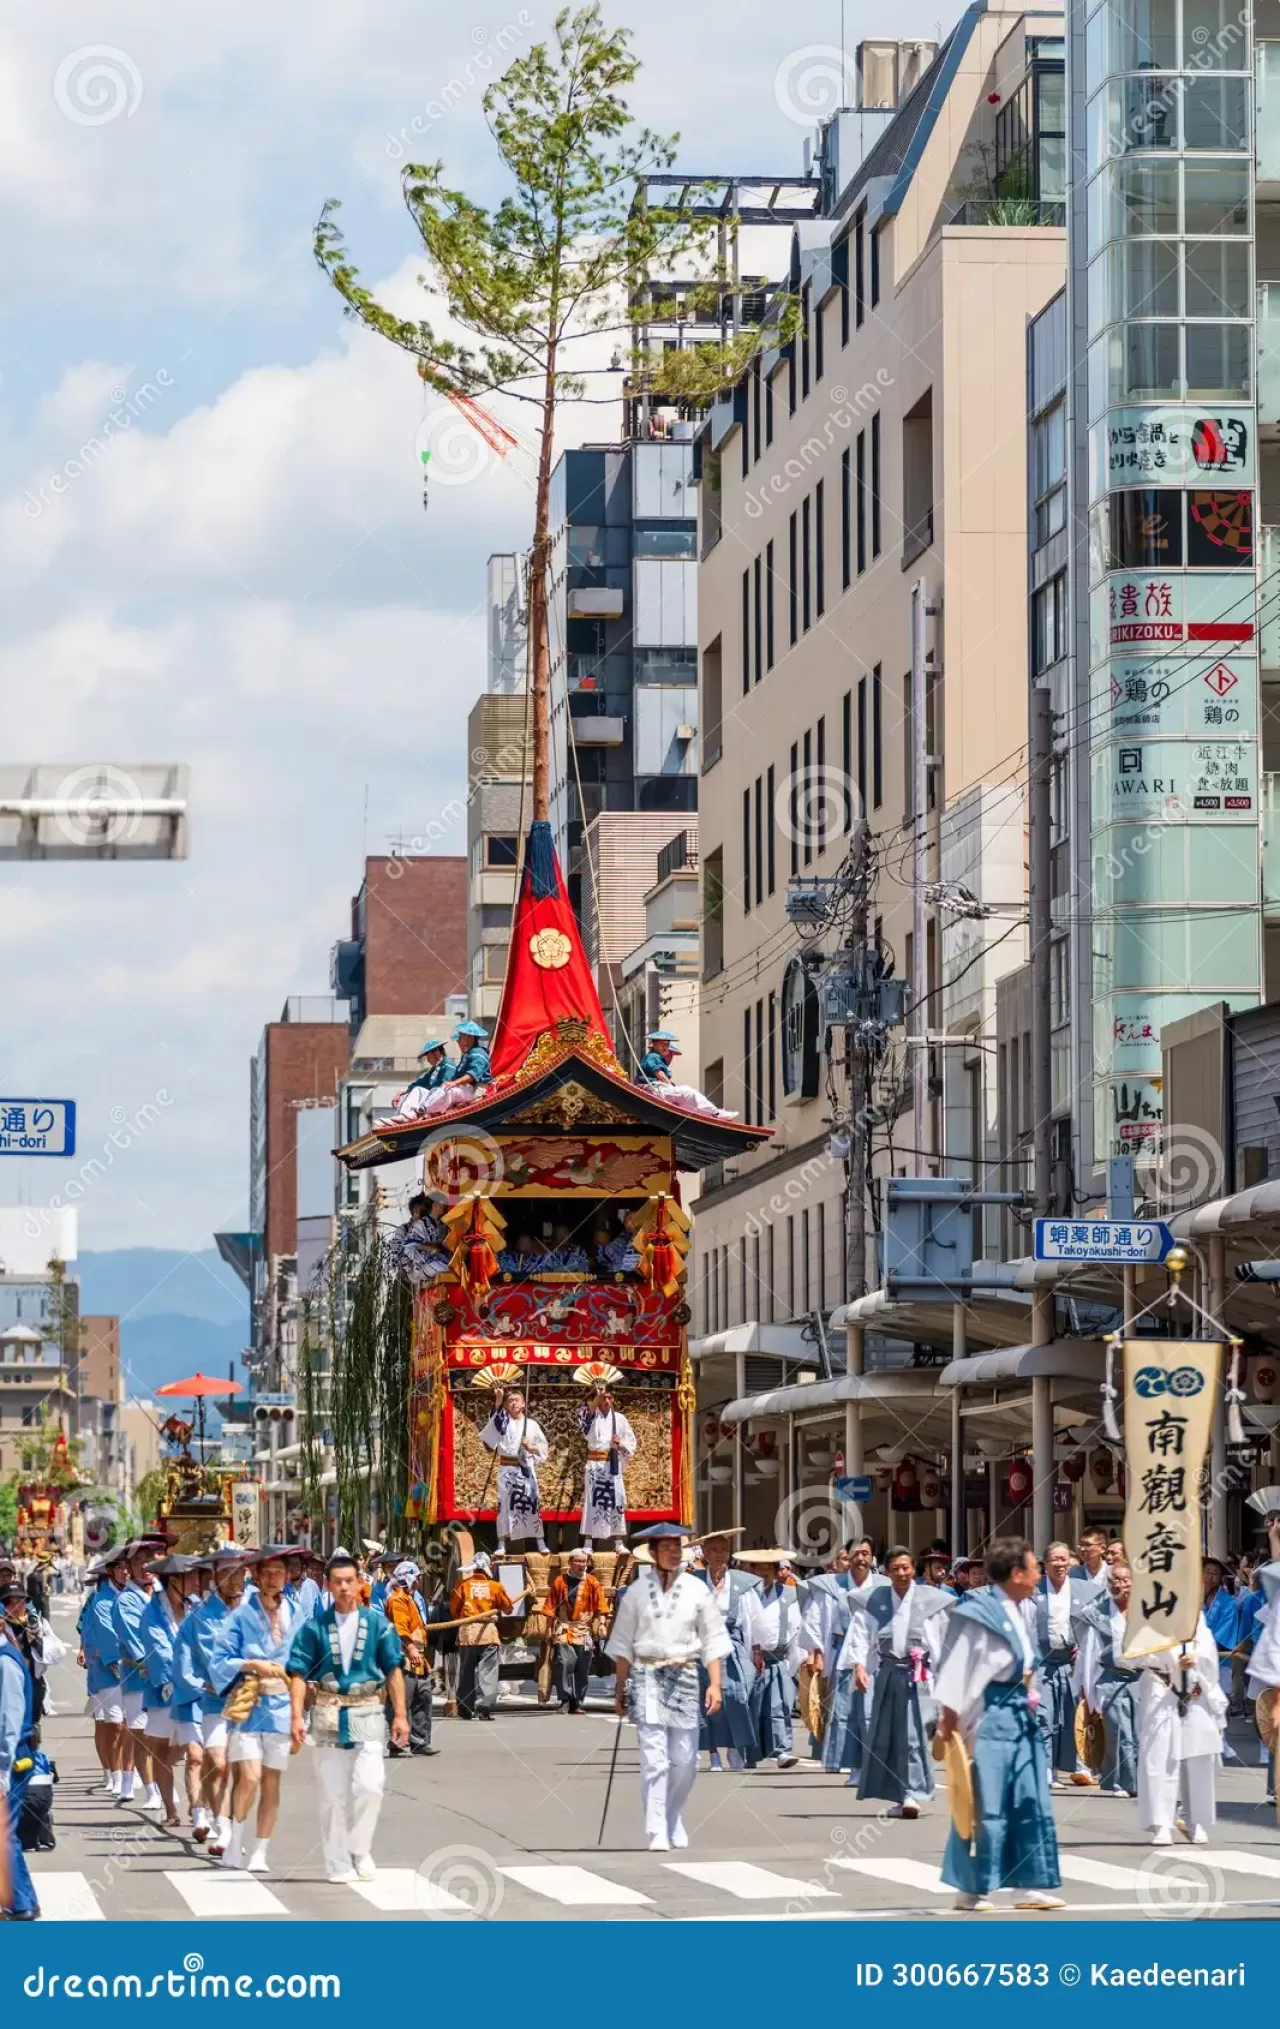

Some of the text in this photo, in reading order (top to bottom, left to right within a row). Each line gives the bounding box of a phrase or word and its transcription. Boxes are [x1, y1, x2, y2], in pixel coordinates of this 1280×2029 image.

[1, 1108, 54, 1132] 通り
[1050, 1225, 1153, 1246] 蛸薬師通り
[1057, 1245, 1147, 1257] Takoyakushi-dori
